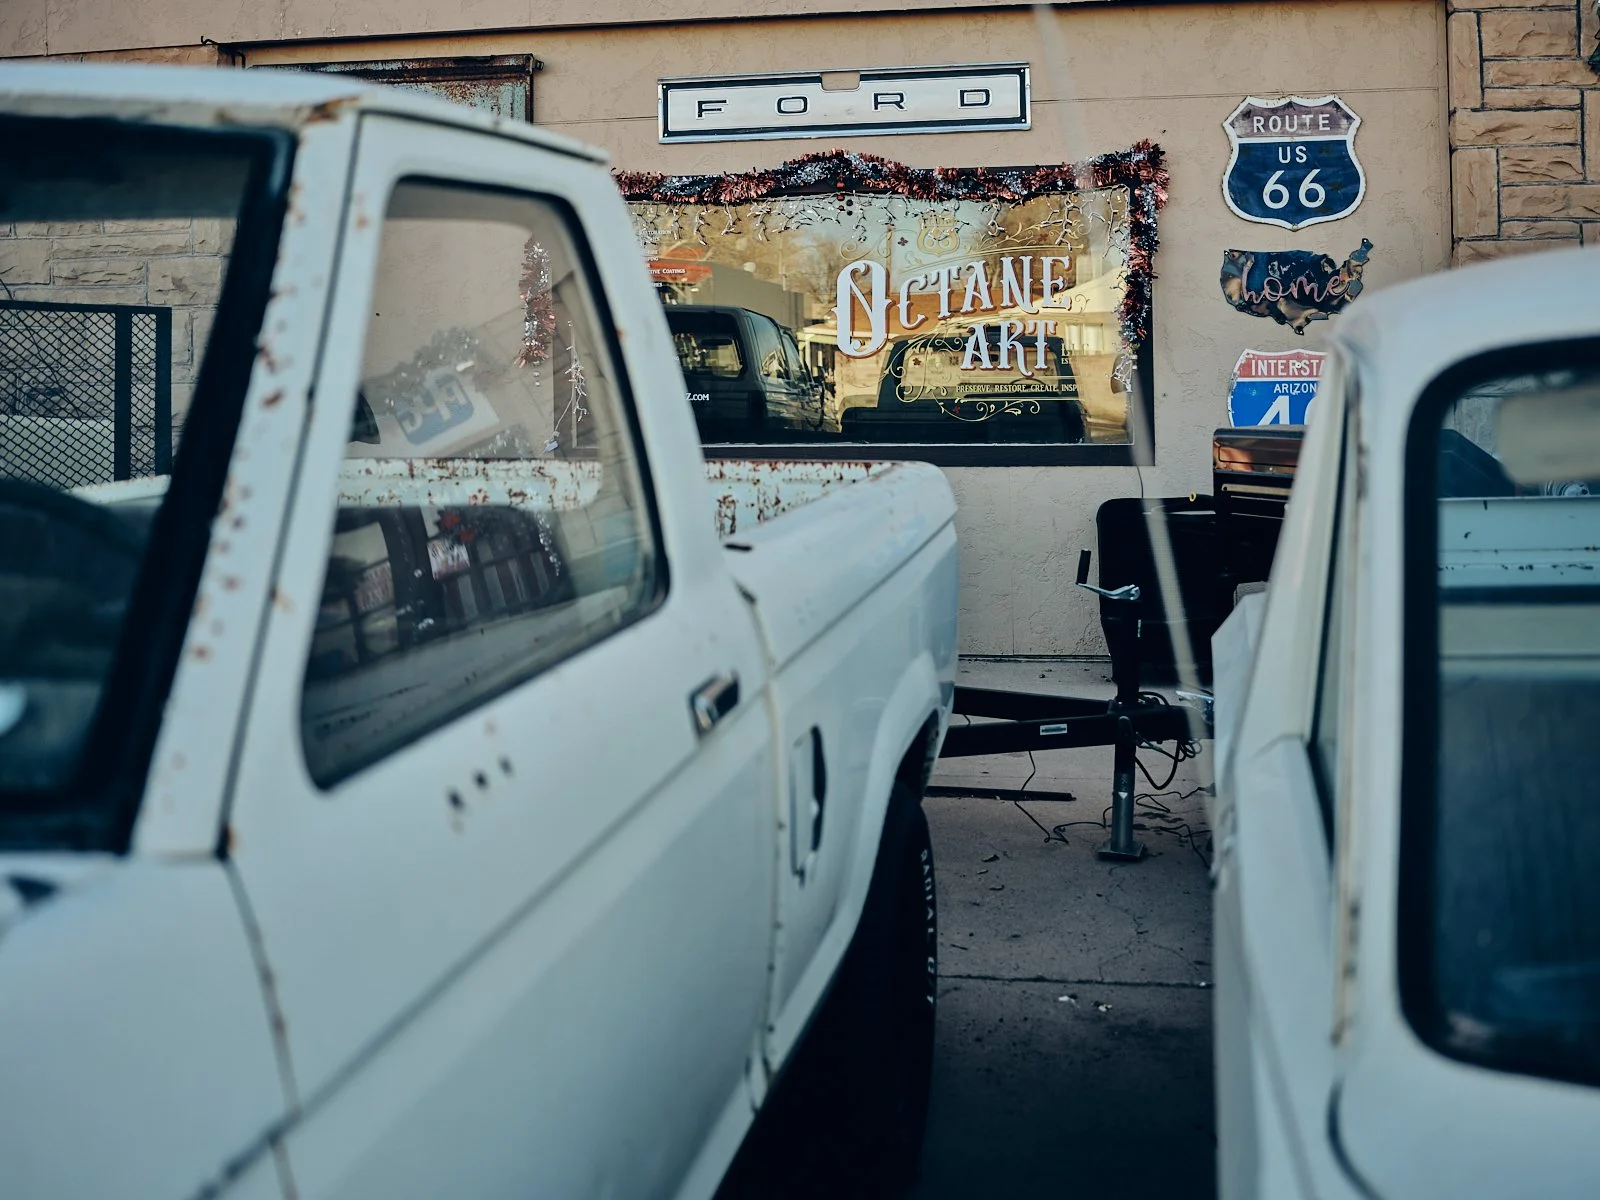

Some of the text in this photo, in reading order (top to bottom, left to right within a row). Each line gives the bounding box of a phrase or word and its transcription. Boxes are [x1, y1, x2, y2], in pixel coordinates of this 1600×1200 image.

[695, 87, 993, 120] FORD
[1253, 113, 1331, 134] ROUTE
[1278, 145, 1307, 164] US
[1262, 168, 1326, 210] 66
[1241, 252, 1350, 304] home
[831, 255, 1073, 358] OCTANE
[960, 319, 1058, 377] ART
